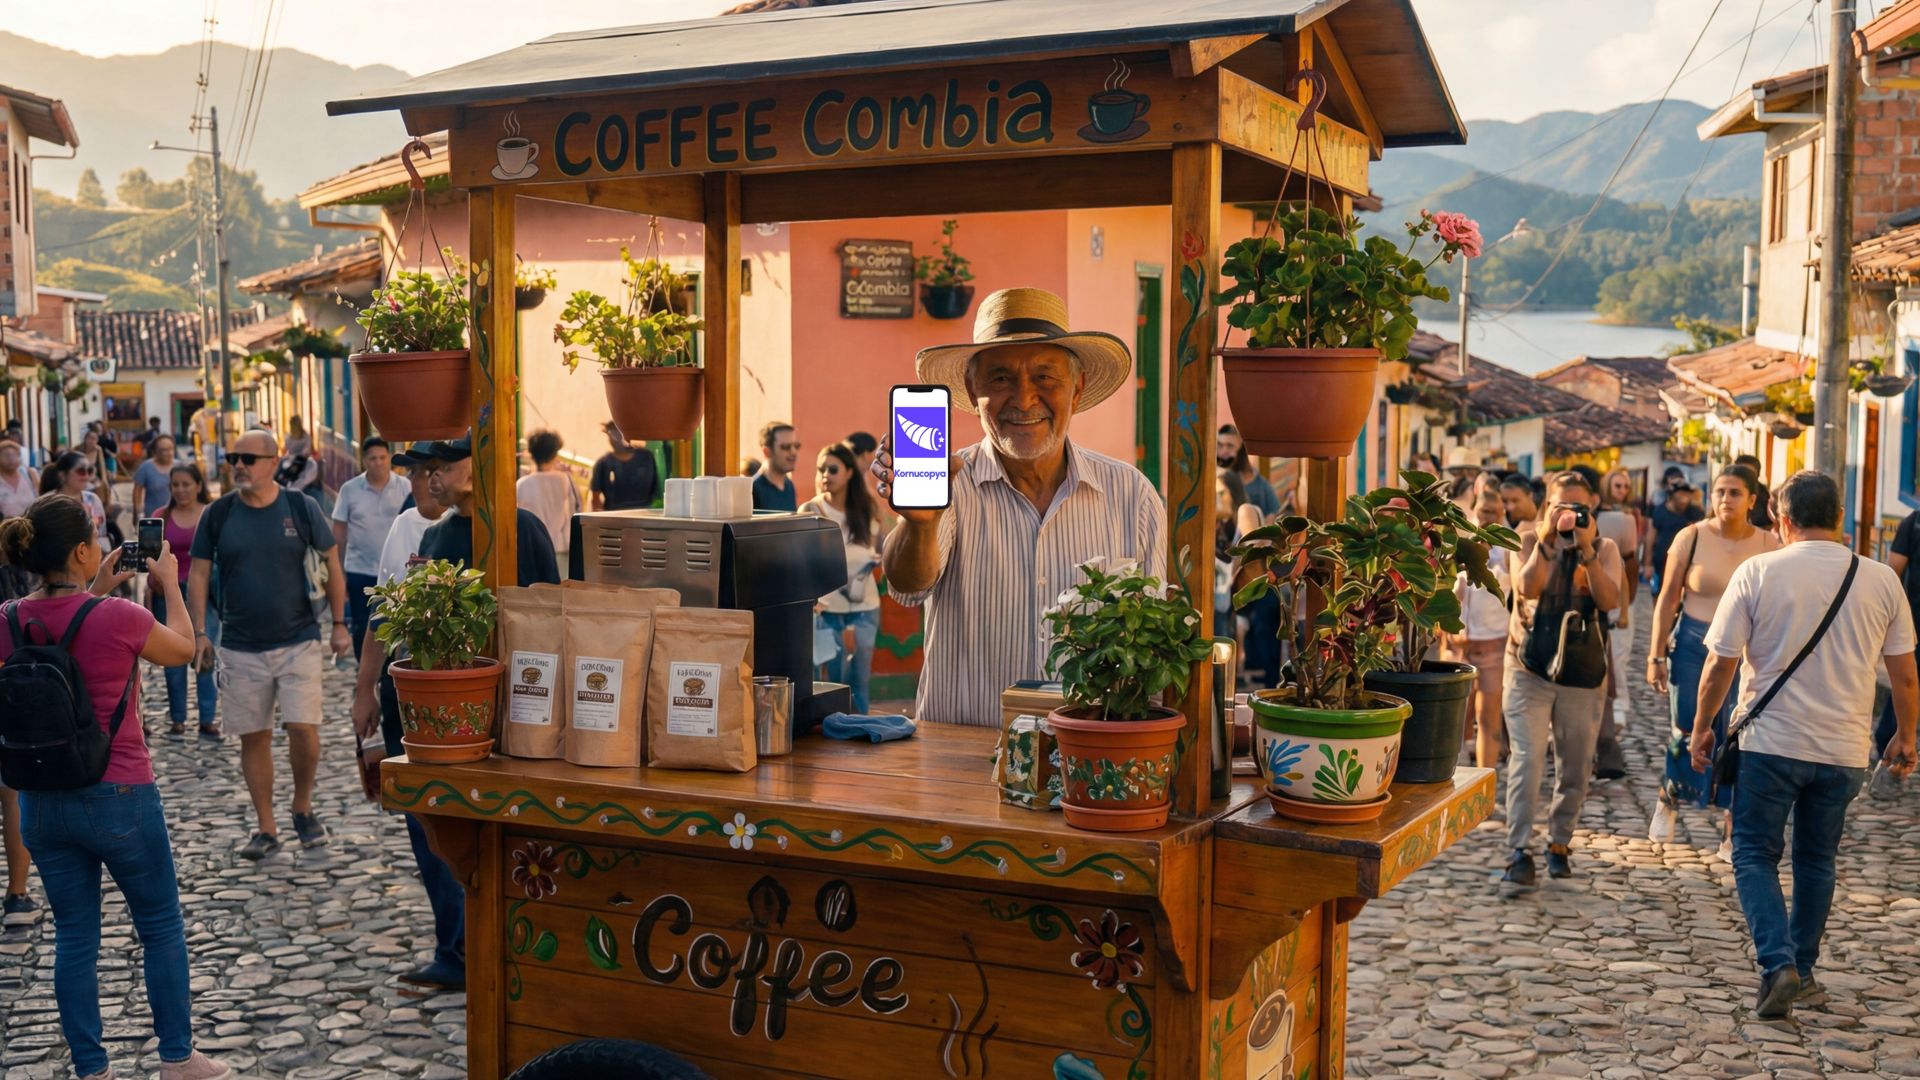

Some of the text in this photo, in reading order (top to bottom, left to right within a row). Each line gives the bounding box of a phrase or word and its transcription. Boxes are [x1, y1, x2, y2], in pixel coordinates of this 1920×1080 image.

[554, 78, 1054, 177] COFFEE Combia
[894, 469, 947, 480] Kornucopya
[633, 893, 909, 1041] Coffee
